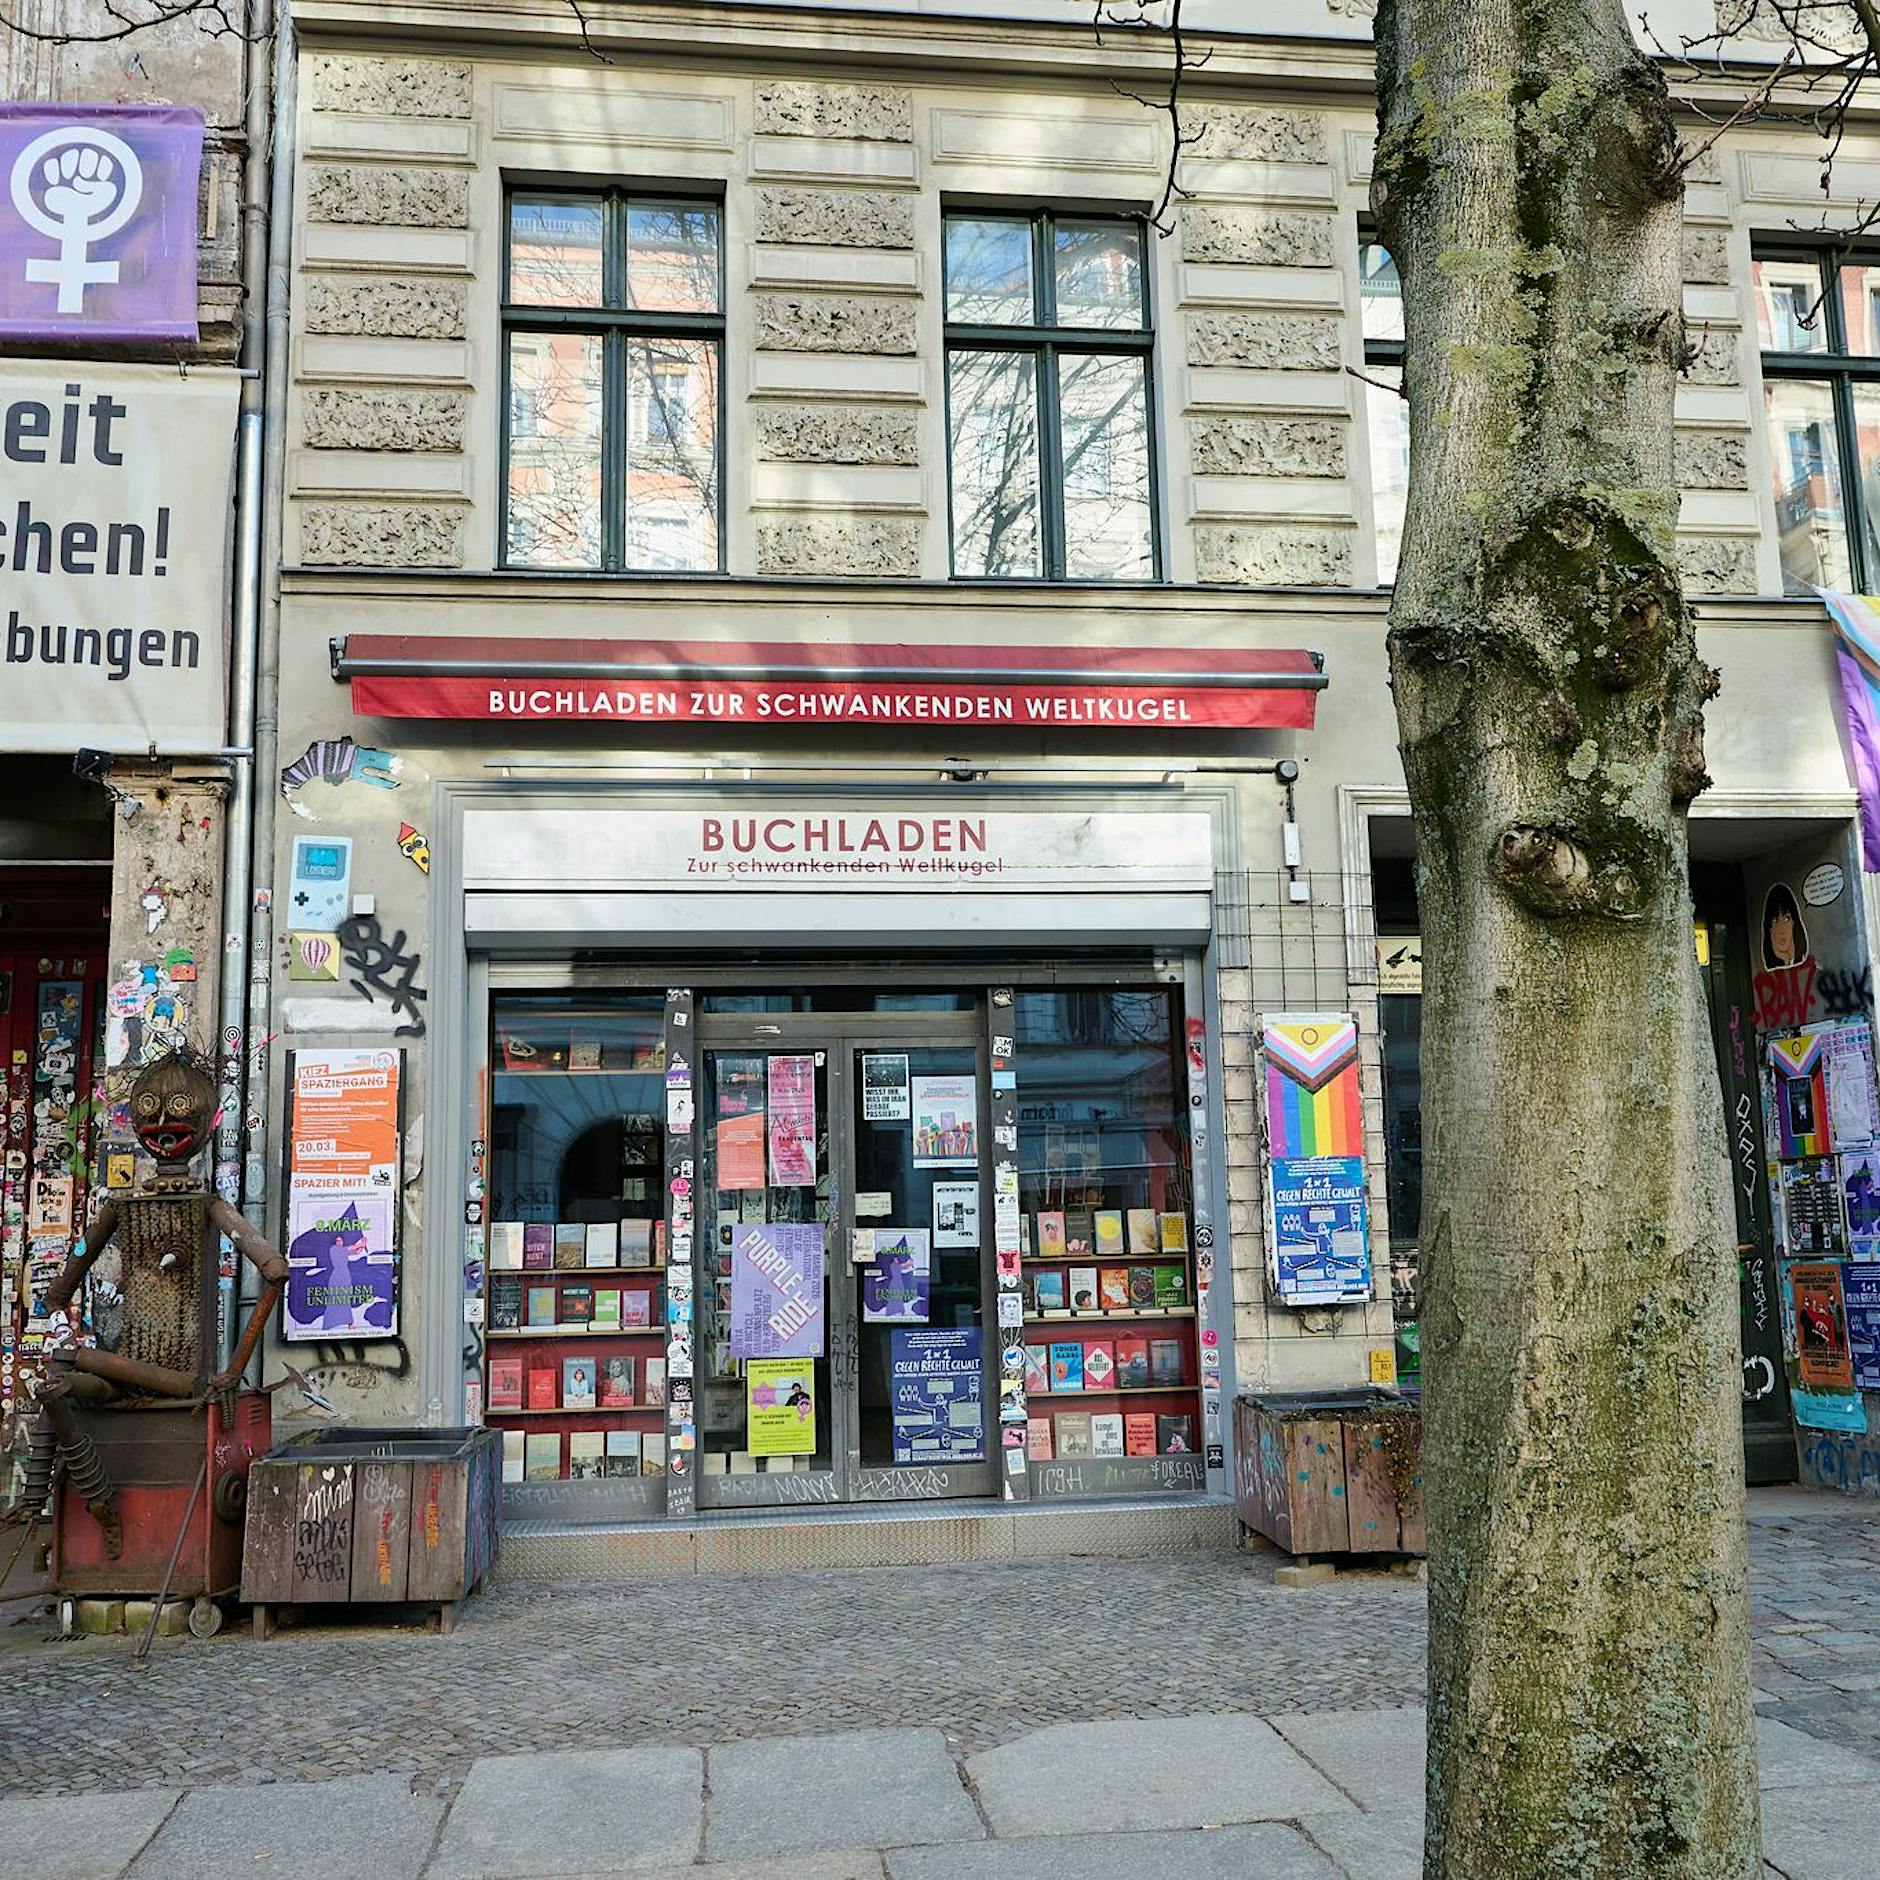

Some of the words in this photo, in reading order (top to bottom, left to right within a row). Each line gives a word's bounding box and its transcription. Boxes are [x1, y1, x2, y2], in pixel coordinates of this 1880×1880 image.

[0, 500, 170, 576] hen!
[488, 689, 677, 715] BUCHLADEN
[690, 692, 745, 716] ZUR
[756, 693, 1013, 719] SCHWANKENDEN
[1025, 697, 1192, 721] WELTKUGEL
[702, 818, 987, 852] BUCHLADEN
[687, 858, 718, 874] Zur
[727, 858, 890, 875] schwankenden
[898, 857, 1003, 876] Weltkugel
[300, 1066, 328, 1078] KIEZ
[301, 1076, 385, 1090] SPAZIERGANG
[298, 1141, 335, 1153] 20.03.
[294, 1178, 341, 1188] SPAZIER
[342, 1177, 367, 1188] MIT!
[1276, 1189, 1301, 1202] GEGEN
[1302, 1188, 1332, 1201] RECHTE
[1332, 1186, 1362, 1199] GEWALT
[738, 1229, 804, 1296] PURPLE
[306, 1284, 373, 1297] FEMINISM
[767, 1290, 819, 1342] RIDE
[894, 1361, 920, 1373] GEGEN
[920, 1359, 950, 1372] RECHTE
[951, 1358, 981, 1371] GEWALT
